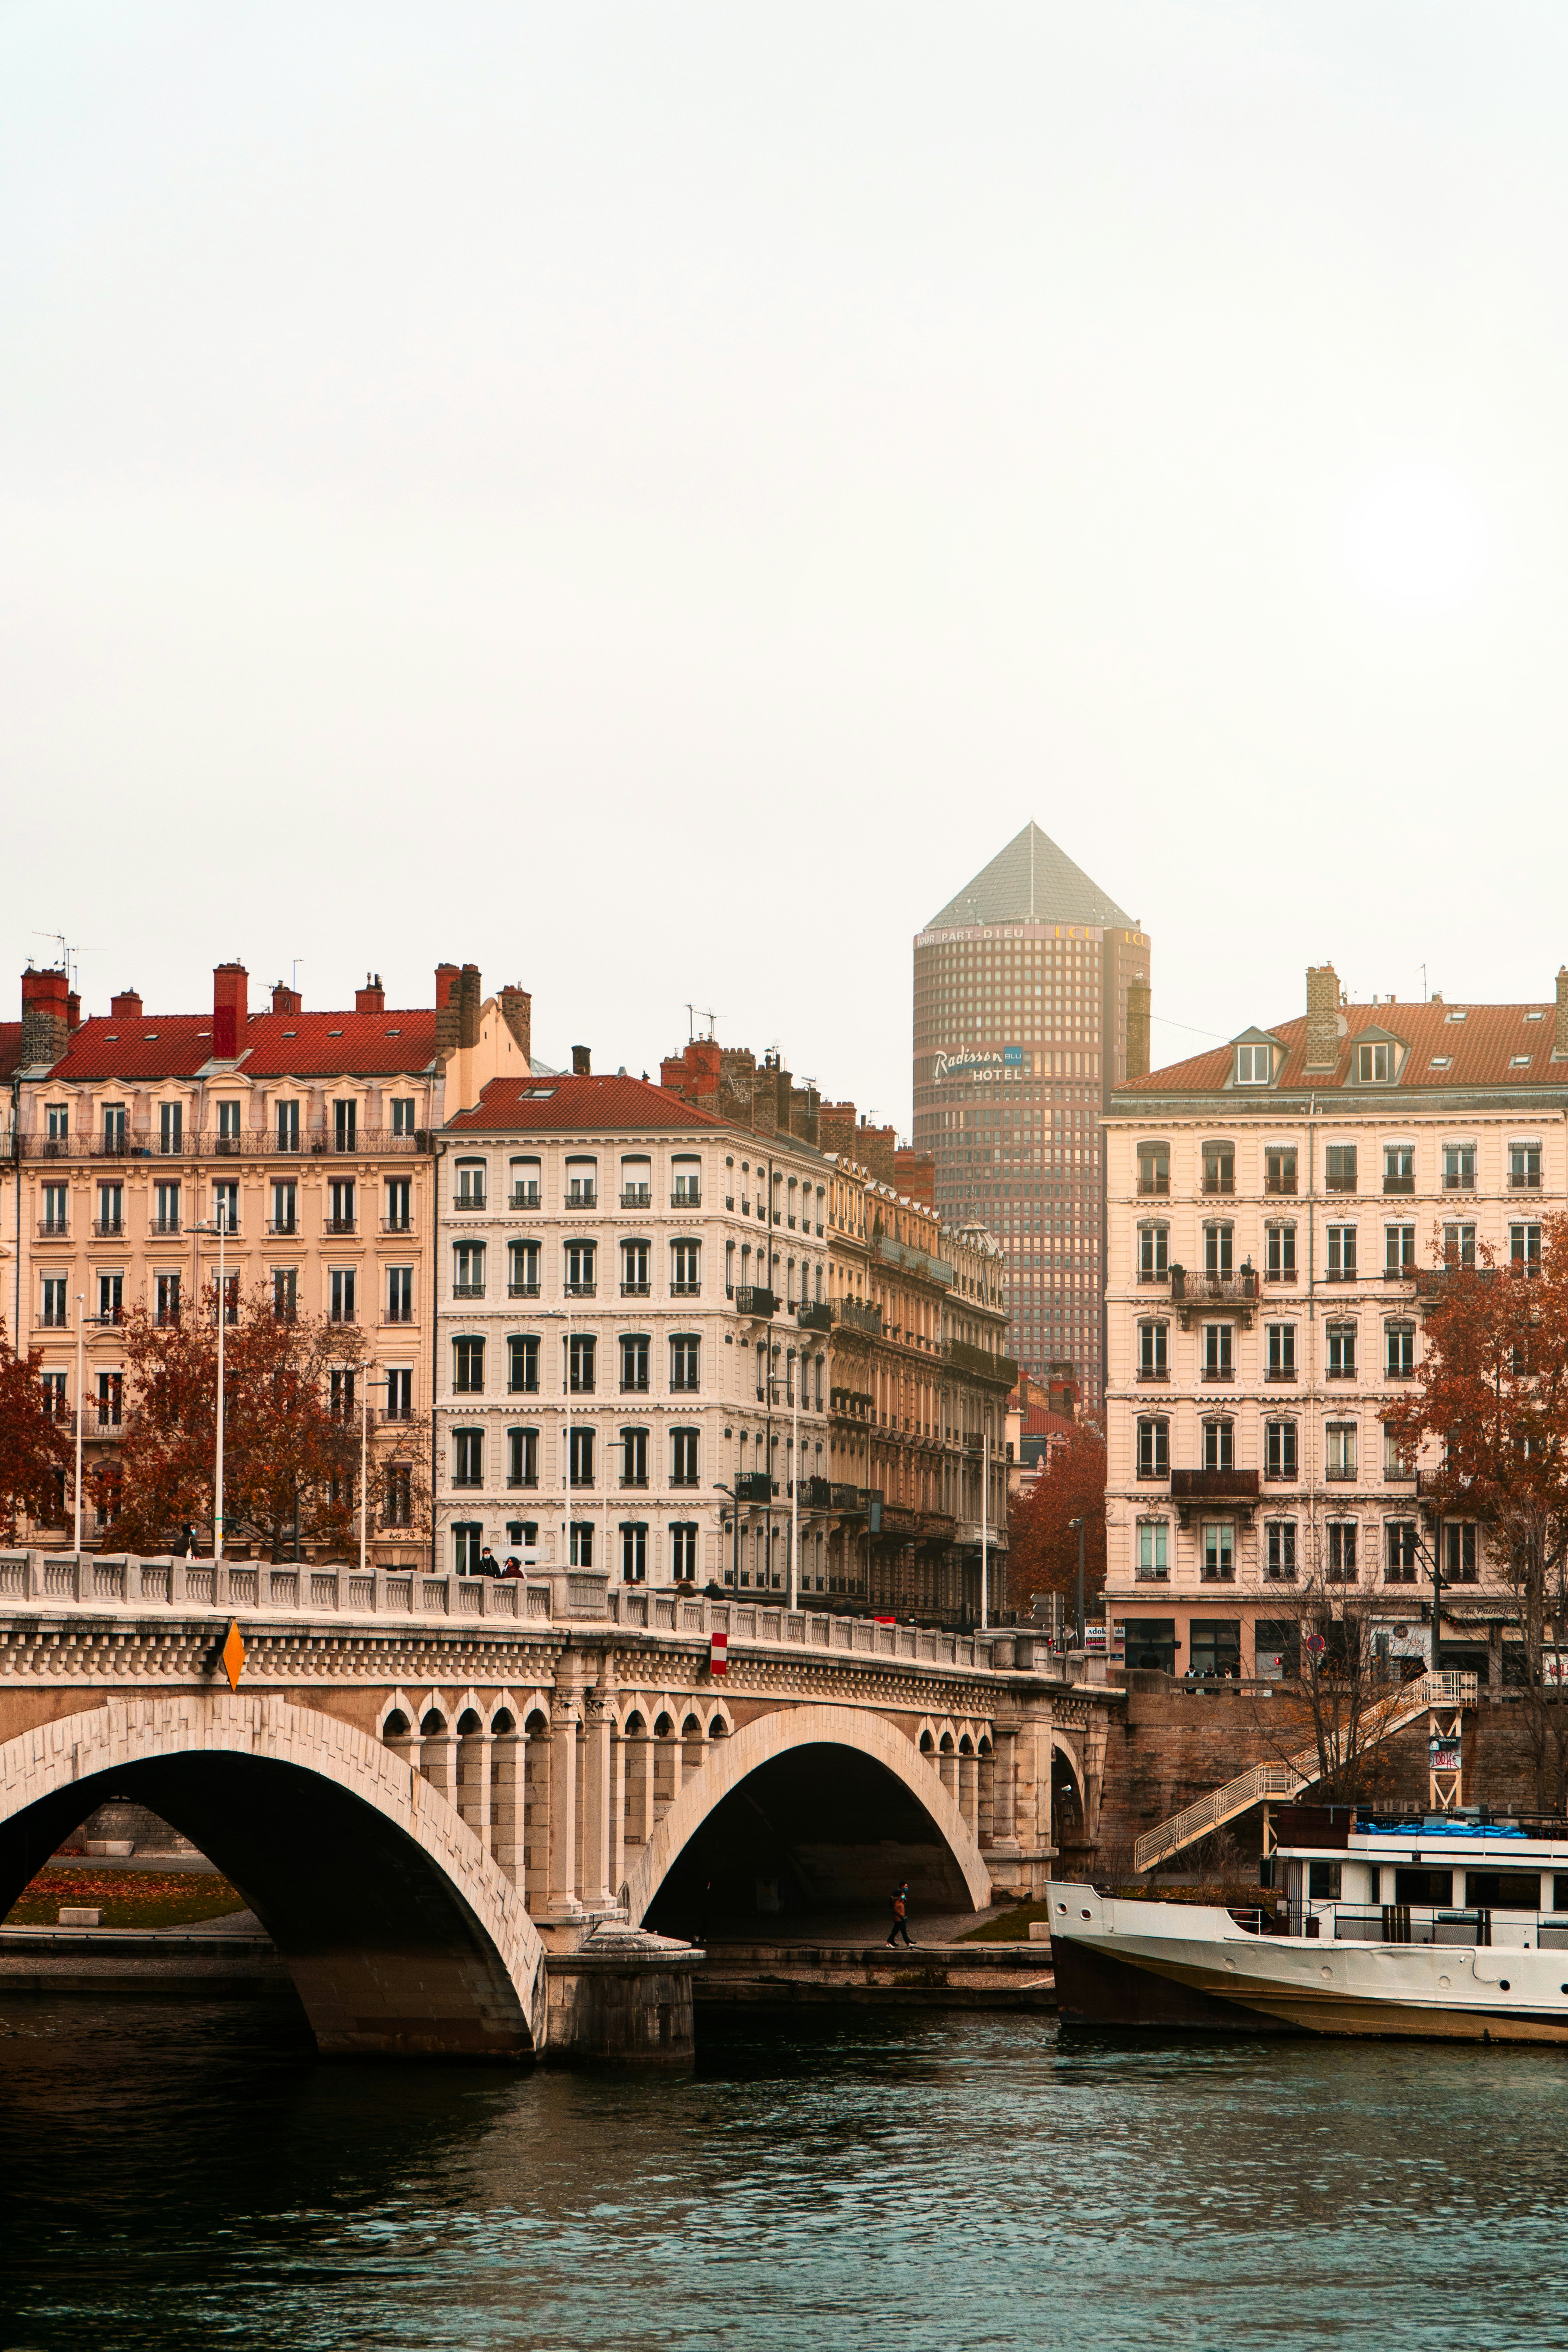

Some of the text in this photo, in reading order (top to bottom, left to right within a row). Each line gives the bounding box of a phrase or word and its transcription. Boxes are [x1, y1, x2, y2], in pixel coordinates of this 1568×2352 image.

[917, 929, 1023, 947] TOUR PART-DIEU
[1055, 926, 1094, 940] LCL
[1125, 931, 1146, 947] LCL
[935, 1045, 1003, 1078] Radisson
[973, 1069, 1022, 1081] HOTEL
[1477, 1606, 1497, 1614] Pain
